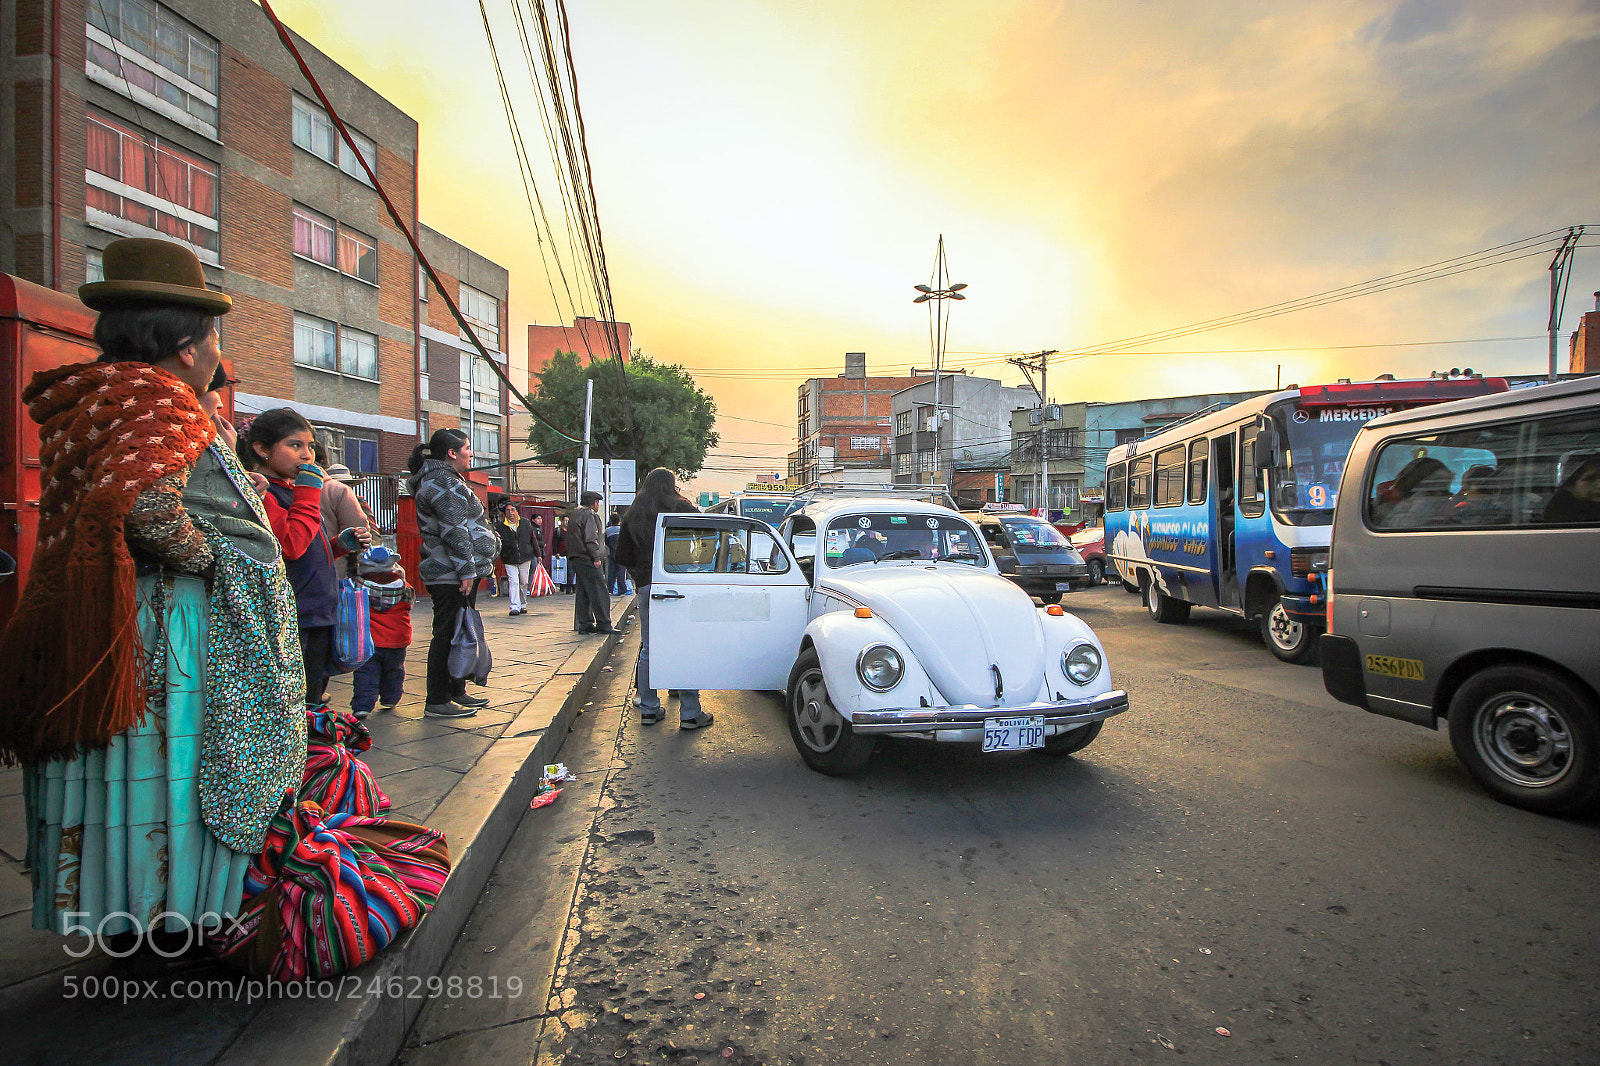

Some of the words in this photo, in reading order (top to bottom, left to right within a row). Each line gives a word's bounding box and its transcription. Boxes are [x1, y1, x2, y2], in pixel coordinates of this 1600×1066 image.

[1309, 485, 1326, 506] 9
[985, 729, 1010, 748] 552
[1018, 727, 1043, 746] FDP
